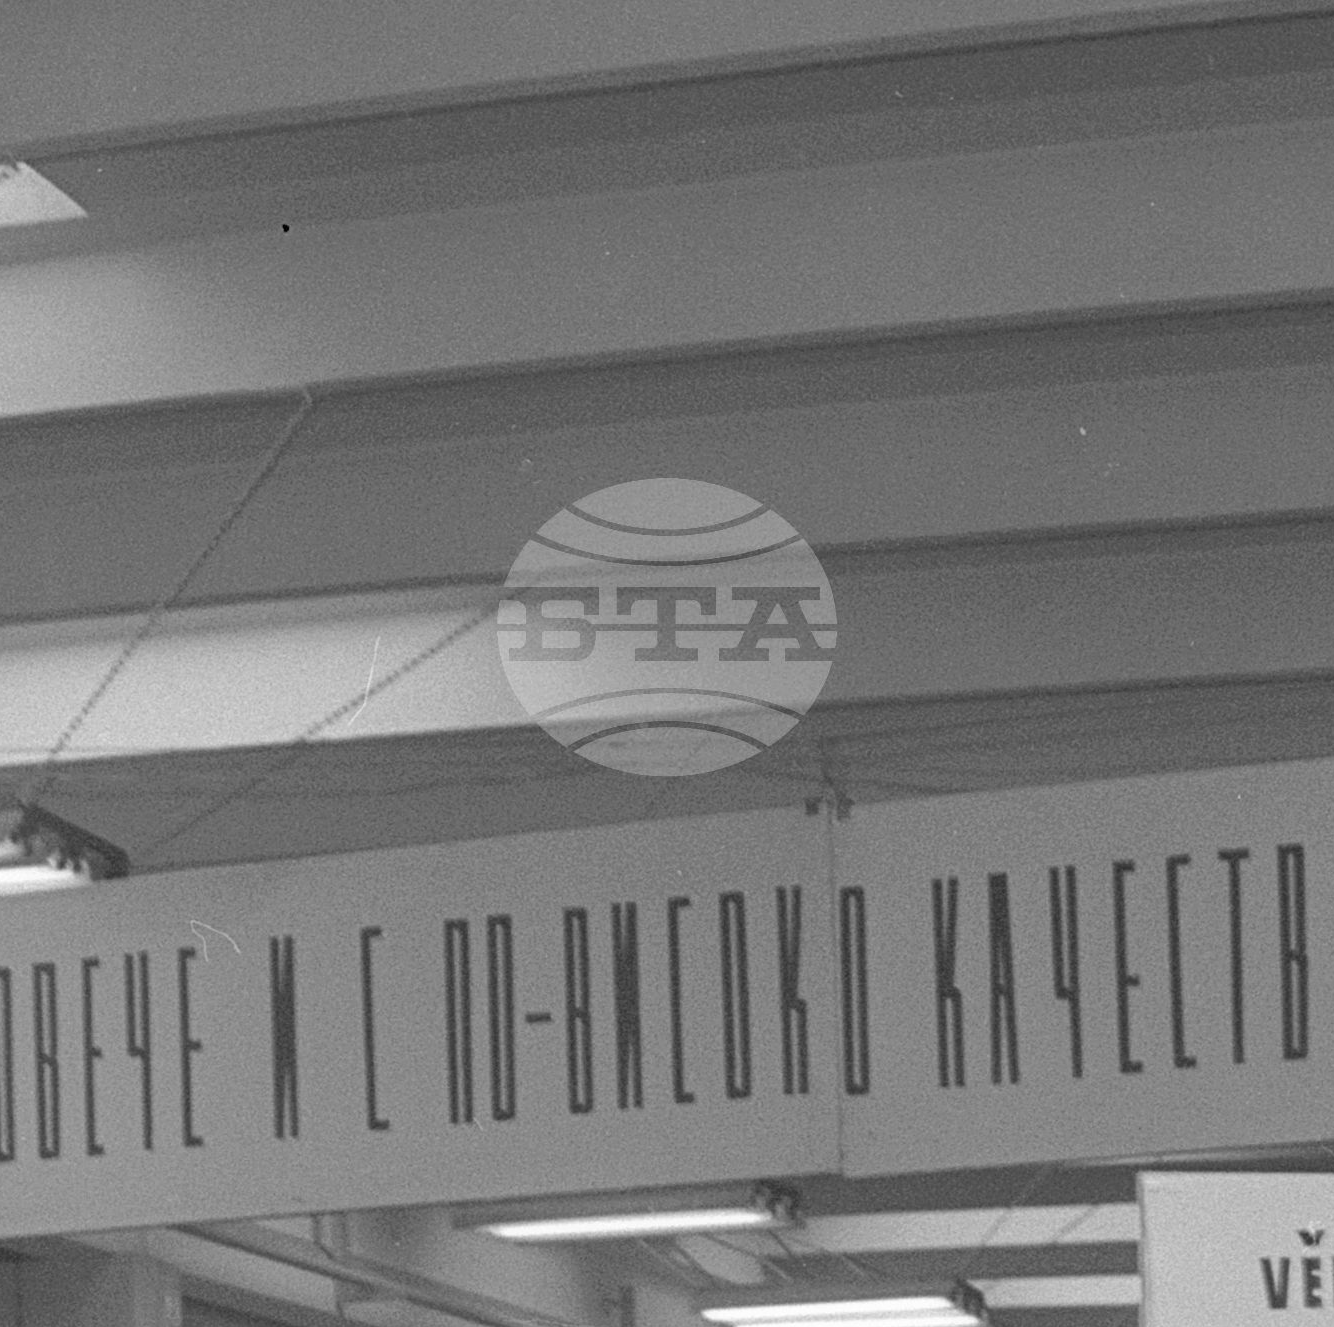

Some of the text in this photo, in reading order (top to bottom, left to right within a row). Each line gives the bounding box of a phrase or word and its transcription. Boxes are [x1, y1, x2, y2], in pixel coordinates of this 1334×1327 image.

[269, 935, 299, 1139] И
[360, 926, 390, 1131] С
[443, 885, 869, 1125] ПО-ВИСОКО
